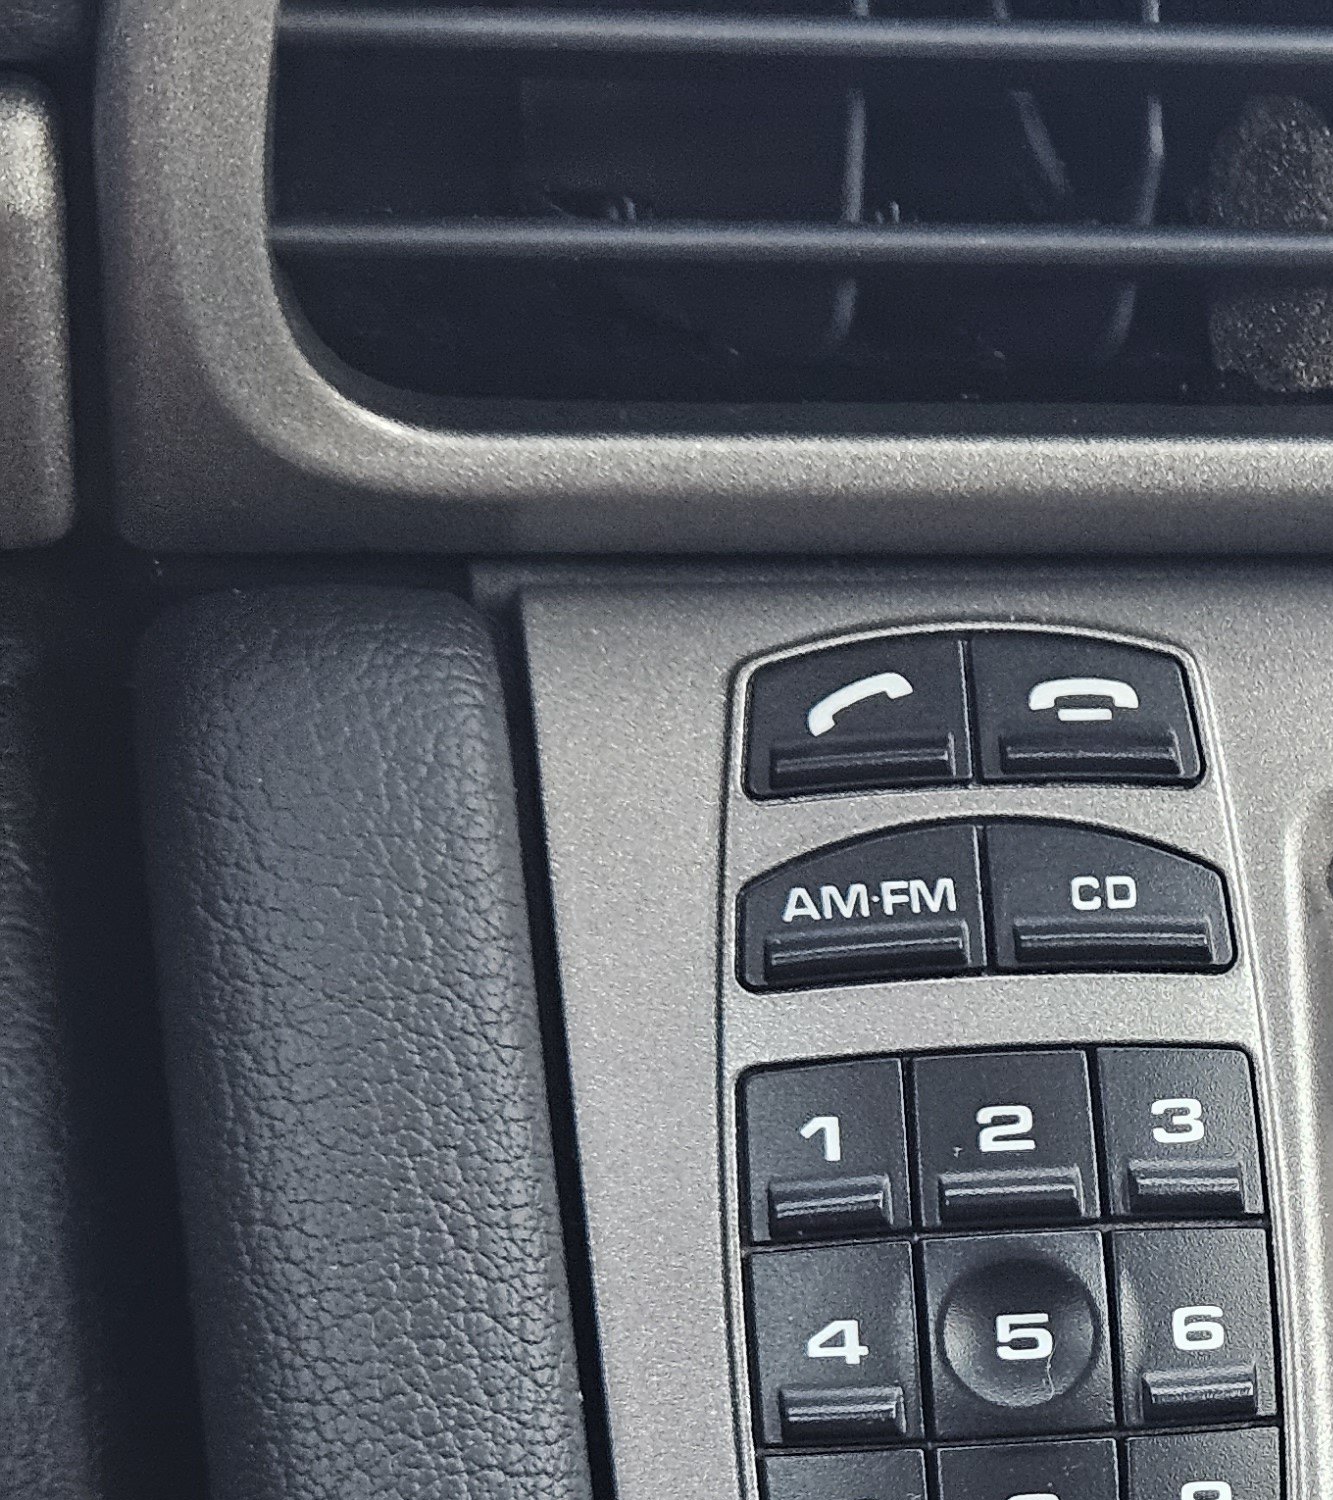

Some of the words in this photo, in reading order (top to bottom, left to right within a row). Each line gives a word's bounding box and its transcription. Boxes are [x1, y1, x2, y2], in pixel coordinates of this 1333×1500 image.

[1069, 875, 1138, 912] CD
[799, 1115, 841, 1162] 1
[975, 1104, 1036, 1153] 2
[1150, 1098, 1205, 1143] 3
[806, 1319, 869, 1365] 4
[995, 1313, 1054, 1360] 5
[1171, 1305, 1225, 1351] 6
